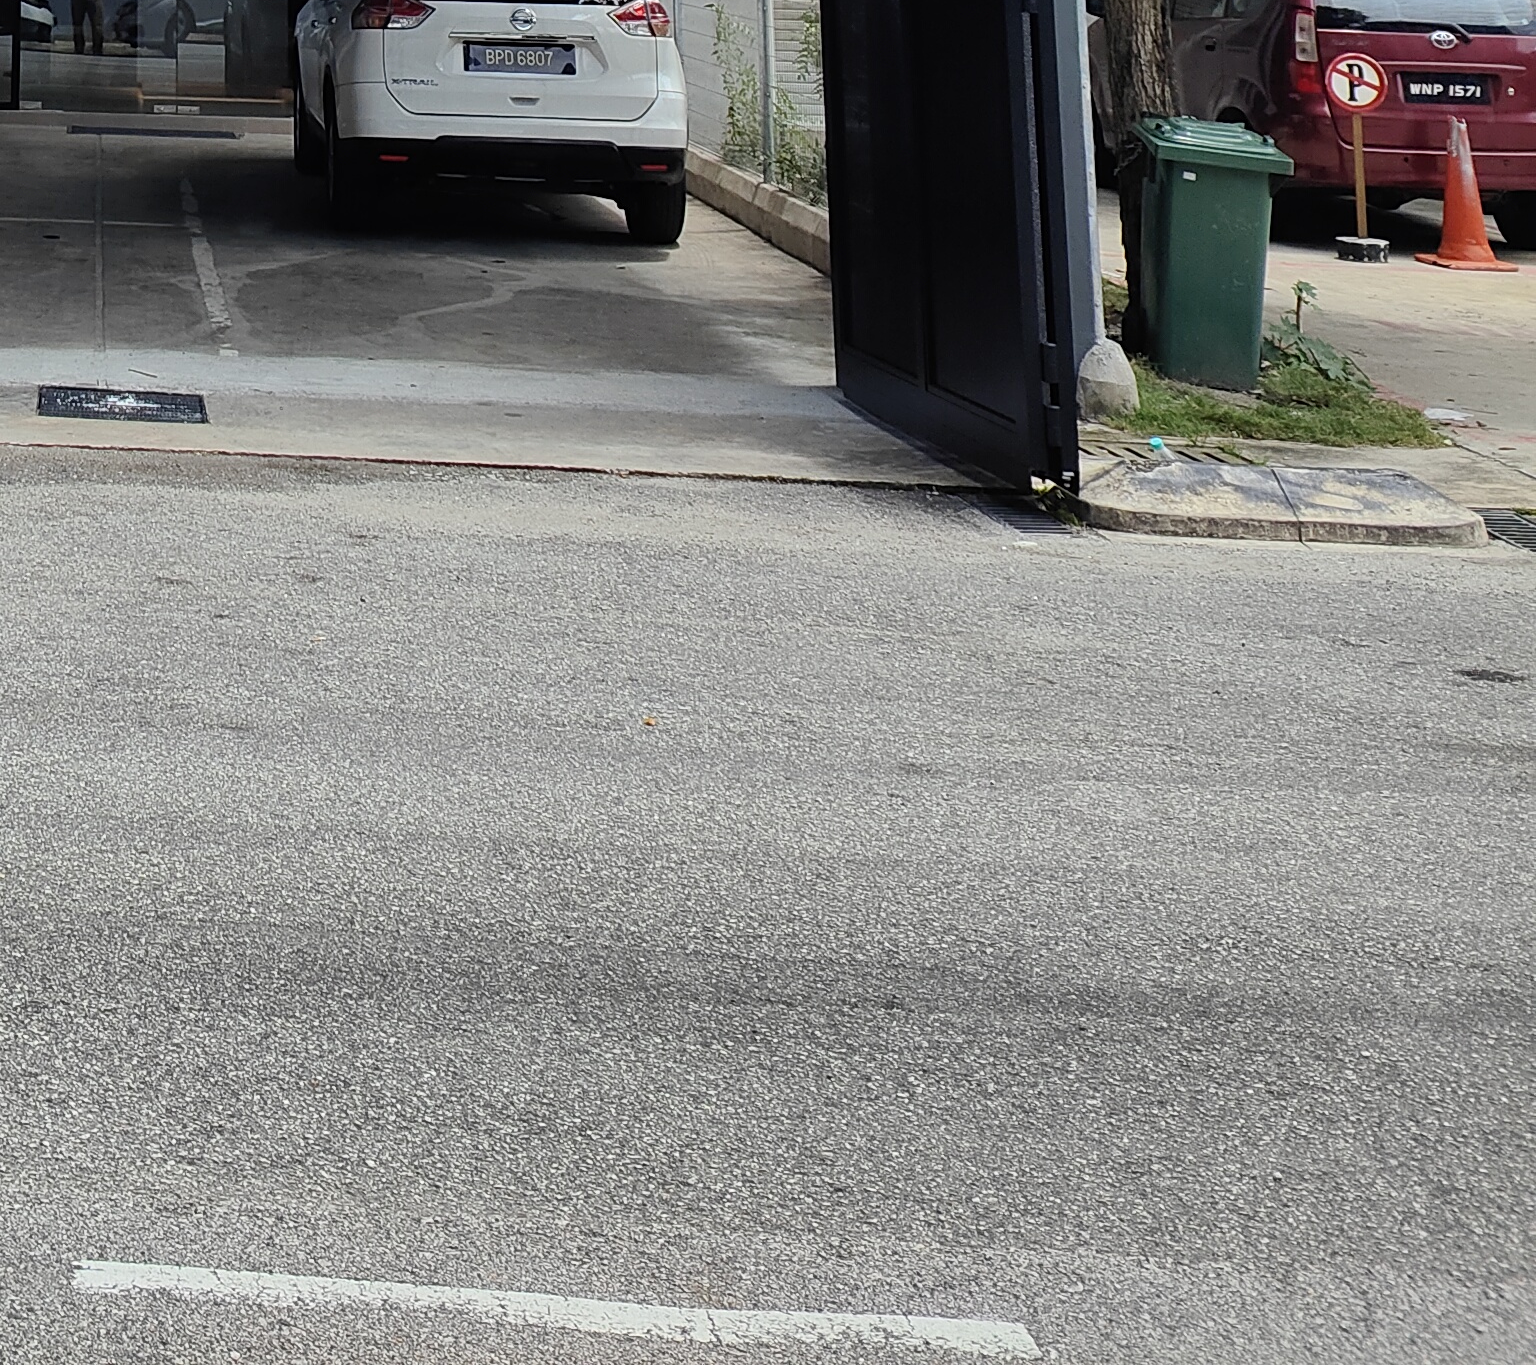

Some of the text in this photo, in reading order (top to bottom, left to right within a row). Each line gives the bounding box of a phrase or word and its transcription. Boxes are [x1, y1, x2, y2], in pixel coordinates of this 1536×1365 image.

[485, 49, 554, 66] BPD 6807
[1409, 82, 1481, 98] WNP 1571
